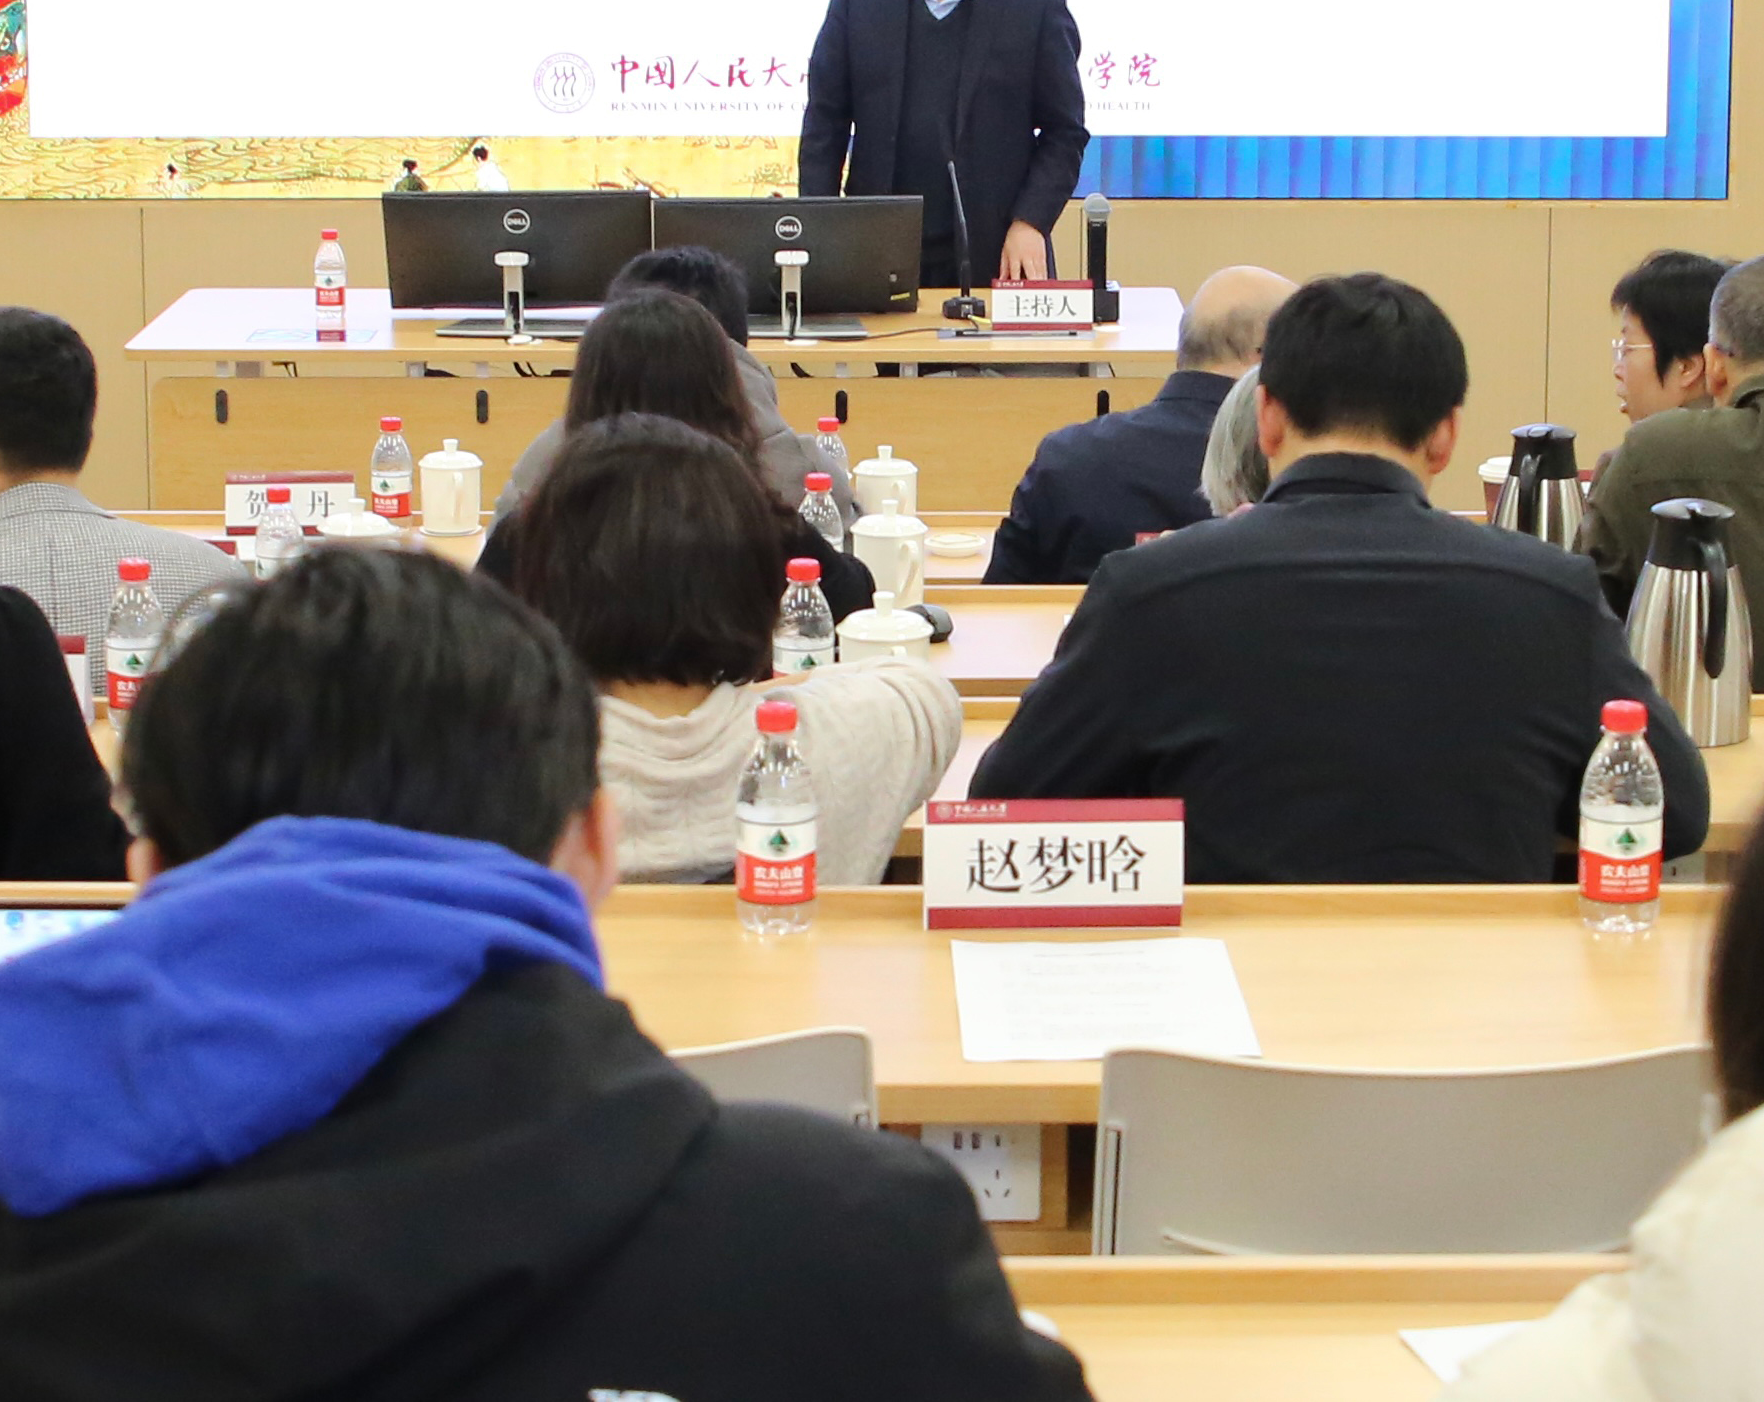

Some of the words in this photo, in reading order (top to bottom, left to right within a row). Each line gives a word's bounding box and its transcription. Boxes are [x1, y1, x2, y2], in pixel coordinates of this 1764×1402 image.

[1008, 294, 1077, 318] 主持人
[966, 834, 1148, 895] 赵梦晗
